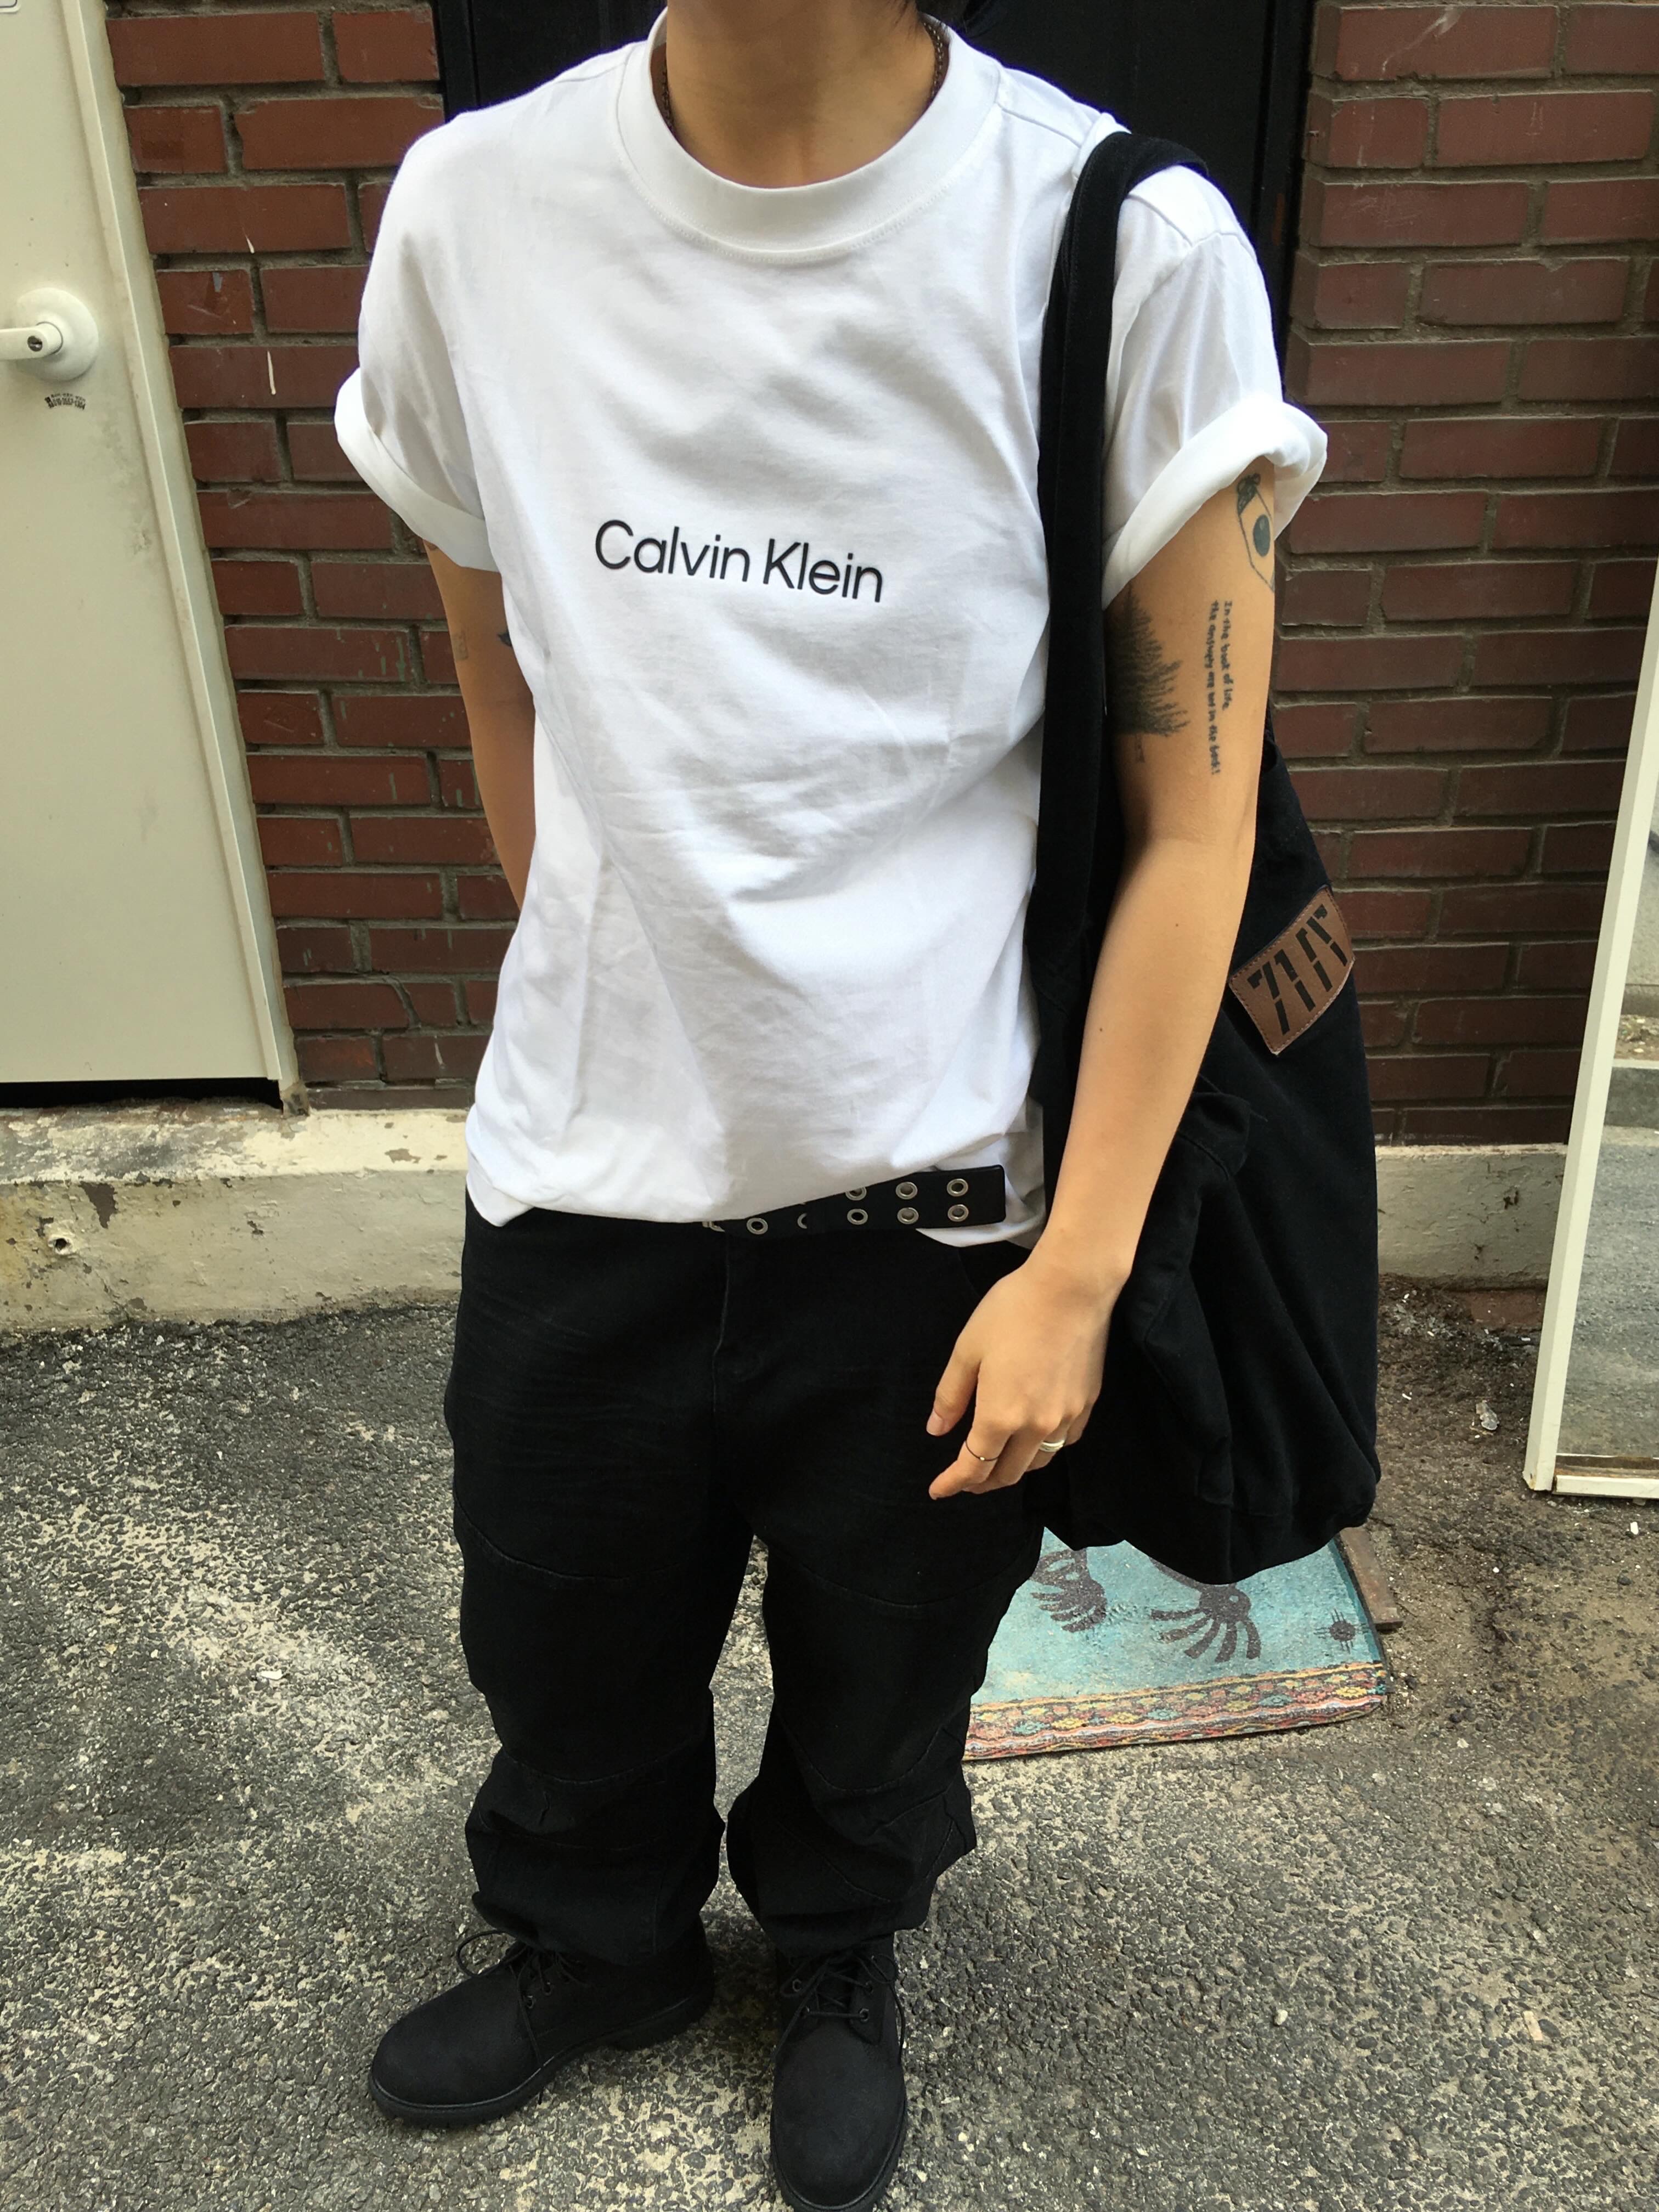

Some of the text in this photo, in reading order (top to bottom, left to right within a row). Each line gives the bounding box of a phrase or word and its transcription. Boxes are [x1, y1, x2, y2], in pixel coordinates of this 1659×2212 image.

[595, 520, 883, 603] Calvin Klein
[1221, 618, 1231, 640] the
